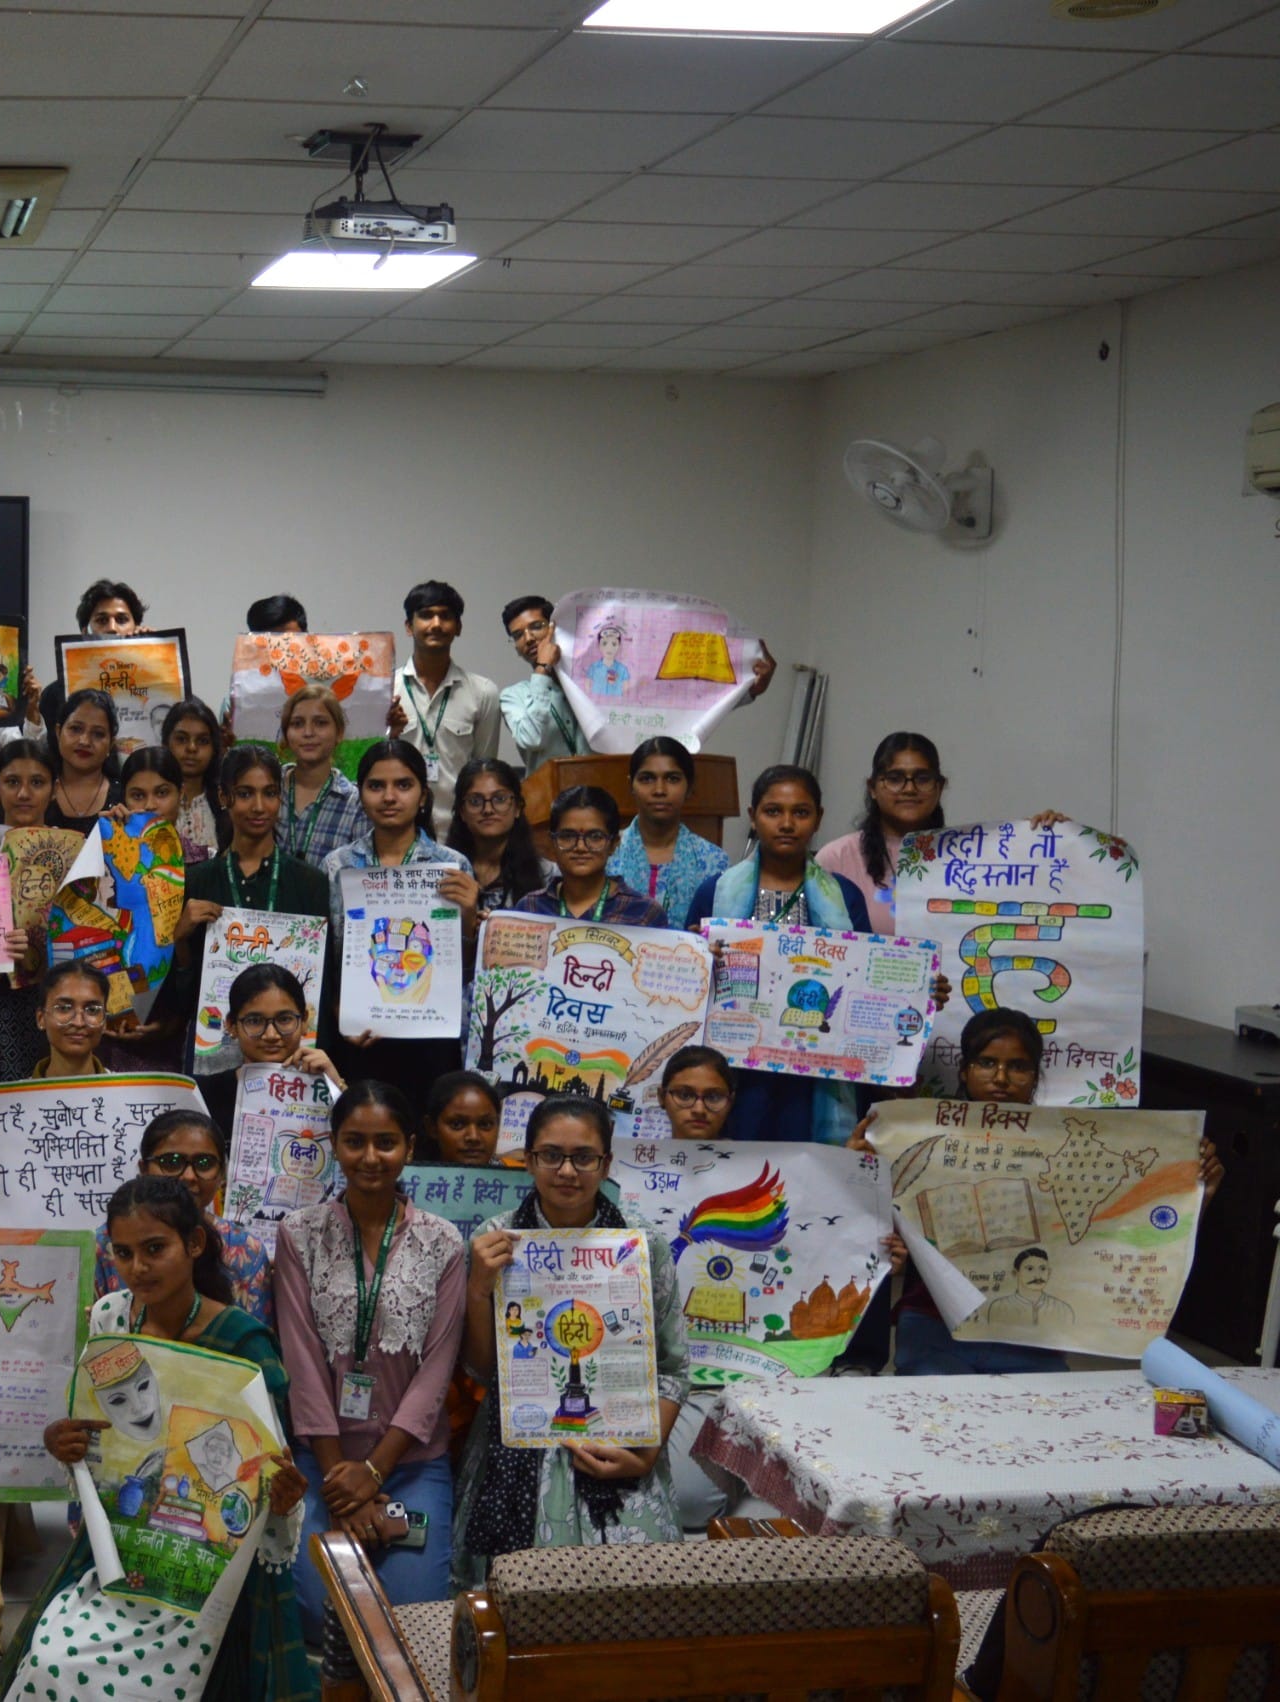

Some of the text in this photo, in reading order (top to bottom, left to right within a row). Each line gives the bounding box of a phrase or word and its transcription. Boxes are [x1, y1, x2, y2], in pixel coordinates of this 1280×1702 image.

[99, 671, 130, 691] हिन्दी
[937, 825, 987, 858] हिंदी
[1029, 825, 1063, 858] तो
[392, 869, 403, 880] के
[407, 868, 423, 880] साथ
[393, 878, 405, 891] की
[407, 879, 419, 890] भी
[943, 858, 1039, 895] हिंदुस्तान
[777, 935, 848, 961] हिंदी दिवस
[563, 955, 617, 992] हिन्दी
[545, 985, 614, 1025] दिवस
[1066, 1042, 1118, 1070] दिवस
[268, 1073, 332, 1106] हिंदी दि
[38, 1099, 88, 1132] सुबोध
[936, 1102, 1032, 1132] हिंदी दिवस
[289, 1141, 320, 1161] हिन्दी
[670, 1152, 689, 1167] की
[15, 1161, 37, 1193] ही
[112, 1154, 126, 1182] है
[641, 1170, 683, 1193] उड़ान
[42, 1187, 65, 1217] ही
[425, 1176, 450, 1204] हमें
[453, 1175, 467, 1202] है
[473, 1175, 510, 1205] हिंदी
[523, 1241, 616, 1274] हिंदी भाषा
[558, 1312, 592, 1346] हिंदी
